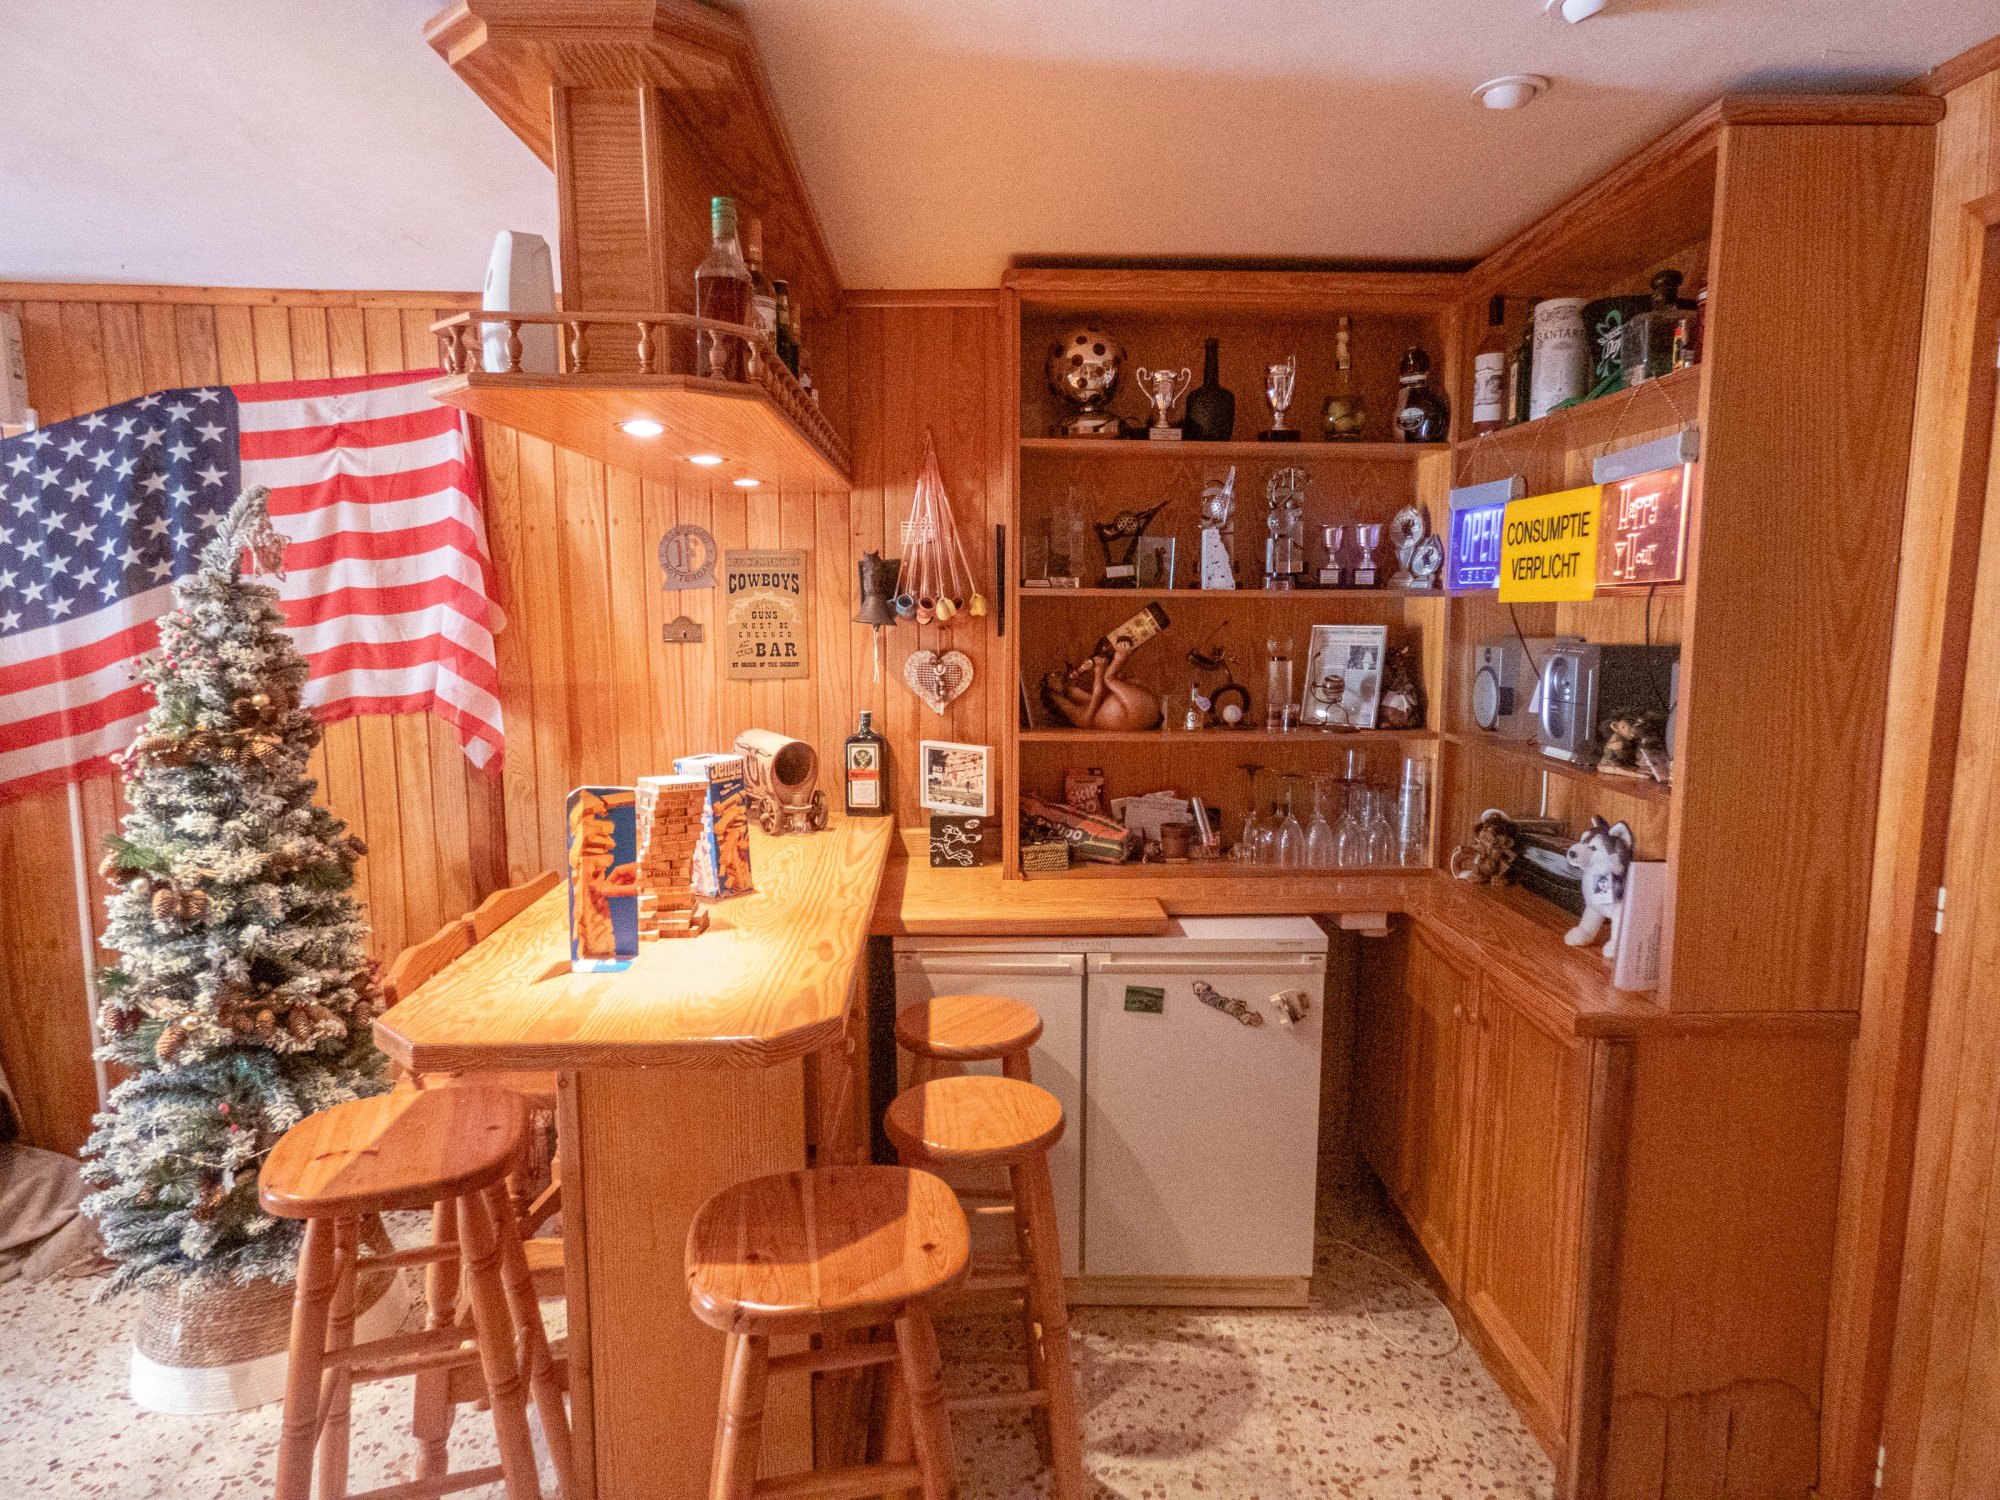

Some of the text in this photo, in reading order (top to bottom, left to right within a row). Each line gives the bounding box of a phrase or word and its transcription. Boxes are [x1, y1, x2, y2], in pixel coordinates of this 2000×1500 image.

[1618, 483, 1662, 530] Happy
[1460, 508, 1504, 563] OPEN
[1507, 511, 1591, 546] CONSUMPTIE
[1511, 552, 1580, 580] VERPLICHT
[1624, 532, 1657, 579] Hour
[728, 573, 800, 595] COWBOYS
[741, 622, 789, 630] MUST BE
[751, 611, 778, 620] GUNS
[738, 631, 792, 639] CHECKED
[755, 642, 798, 658] BAR
[711, 762, 742, 780] Jenga
